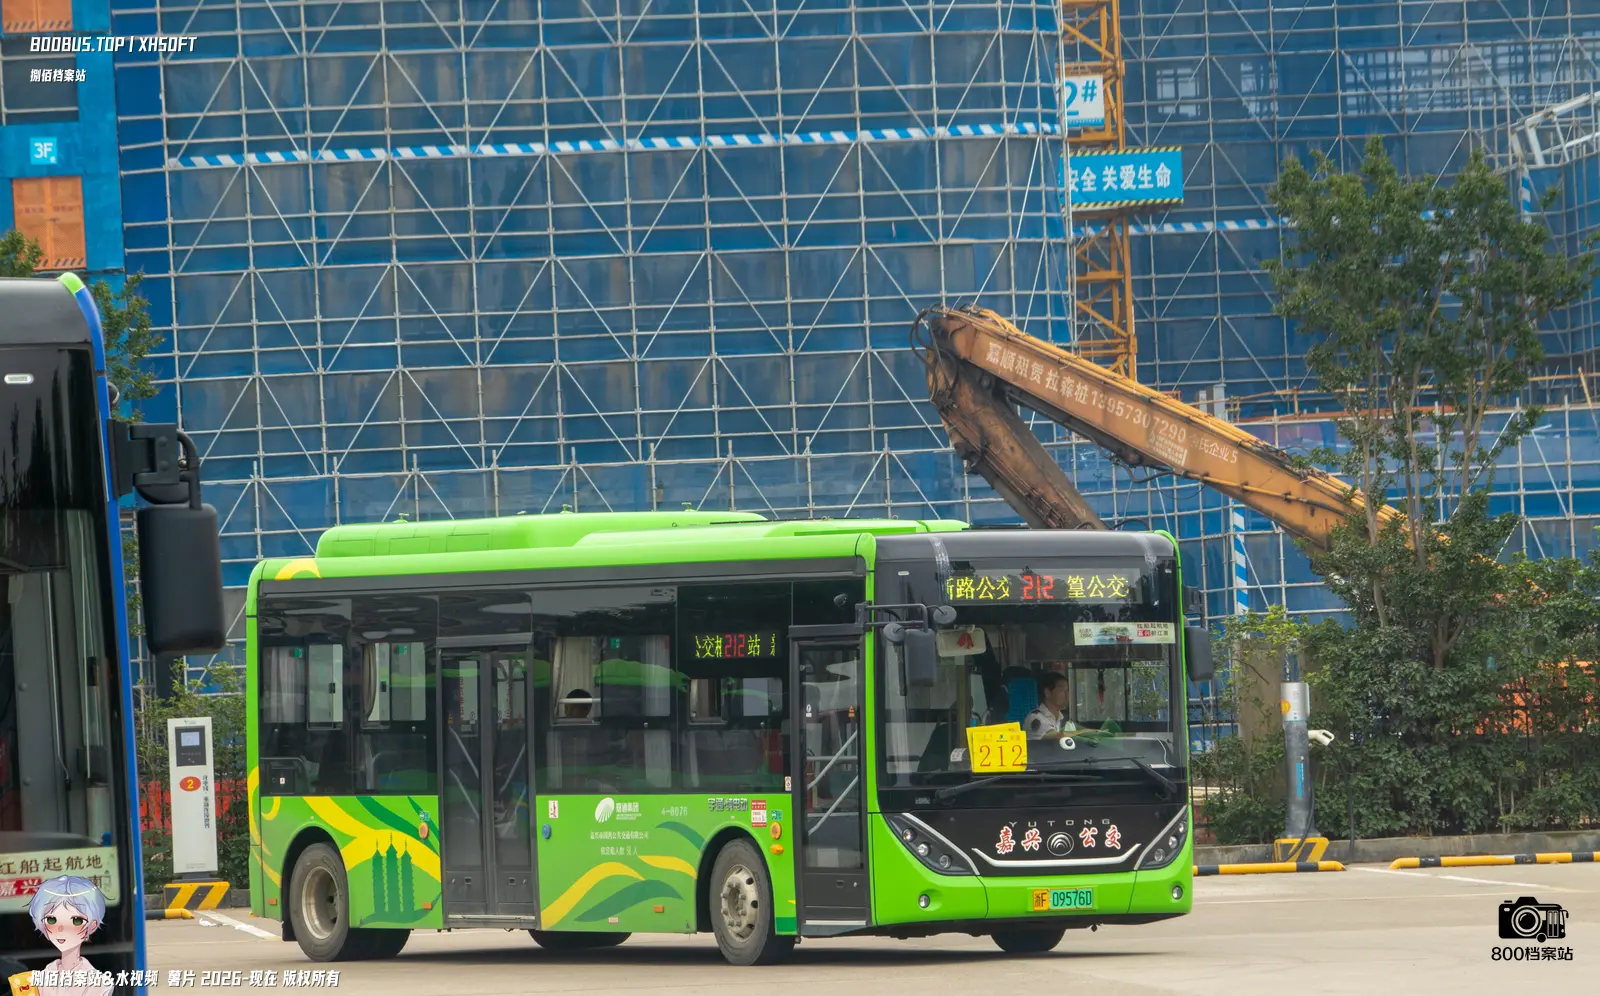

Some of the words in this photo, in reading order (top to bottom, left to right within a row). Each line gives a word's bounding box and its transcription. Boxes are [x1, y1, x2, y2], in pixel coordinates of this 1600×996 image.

[34, 142, 53, 158] 3F
[1102, 161, 1172, 191] 关爱生命
[1023, 575, 1054, 599] 212
[724, 634, 745, 657] 212
[979, 744, 1023, 767] 212
[186, 779, 194, 789] 2
[1008, 819, 1111, 828] YUTONG
